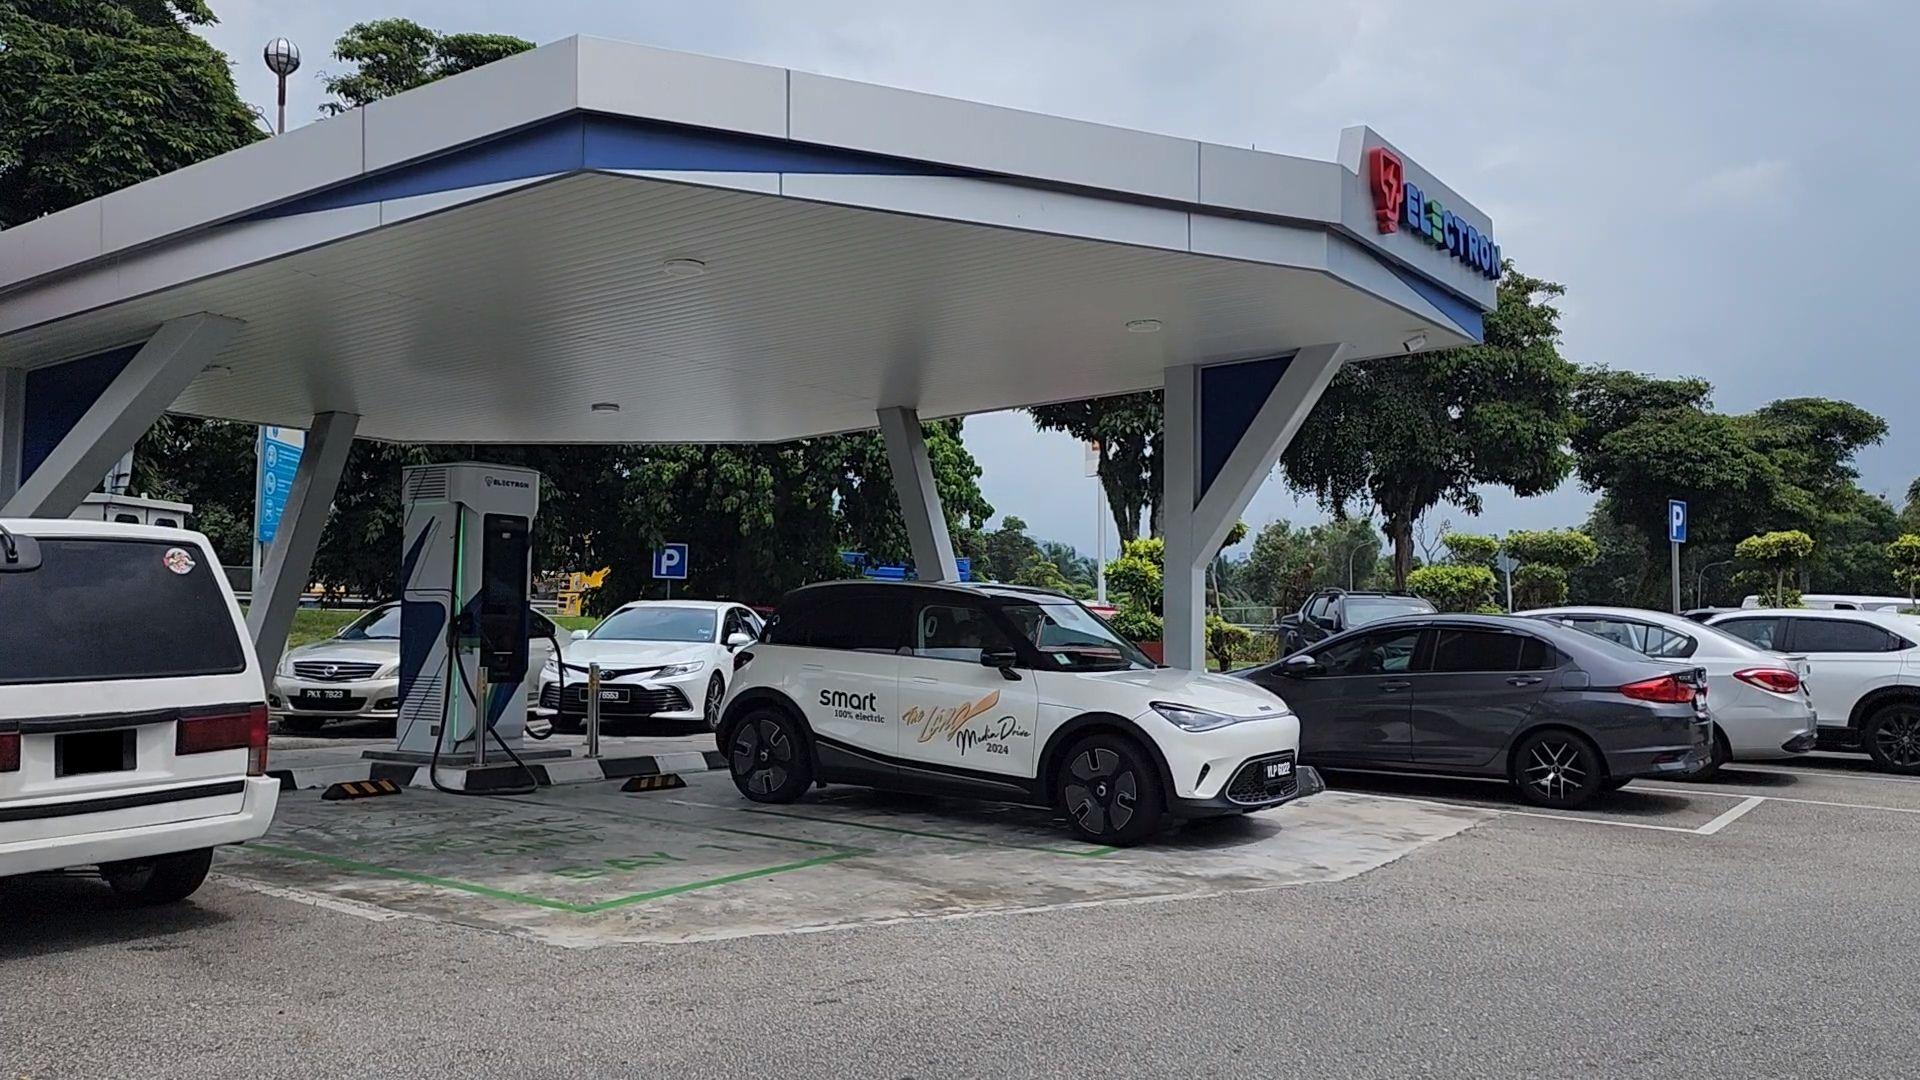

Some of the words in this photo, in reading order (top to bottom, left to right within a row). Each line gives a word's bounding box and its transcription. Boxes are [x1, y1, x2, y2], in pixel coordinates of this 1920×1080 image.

[1403, 181, 1502, 280] ELECTRON
[1672, 505, 1684, 538] P
[660, 548, 681, 575] P
[819, 689, 877, 712] smart
[834, 709, 854, 720] 100%
[855, 712, 885, 723] electric
[997, 716, 1032, 740] Drive
[986, 742, 1009, 755] 2024
